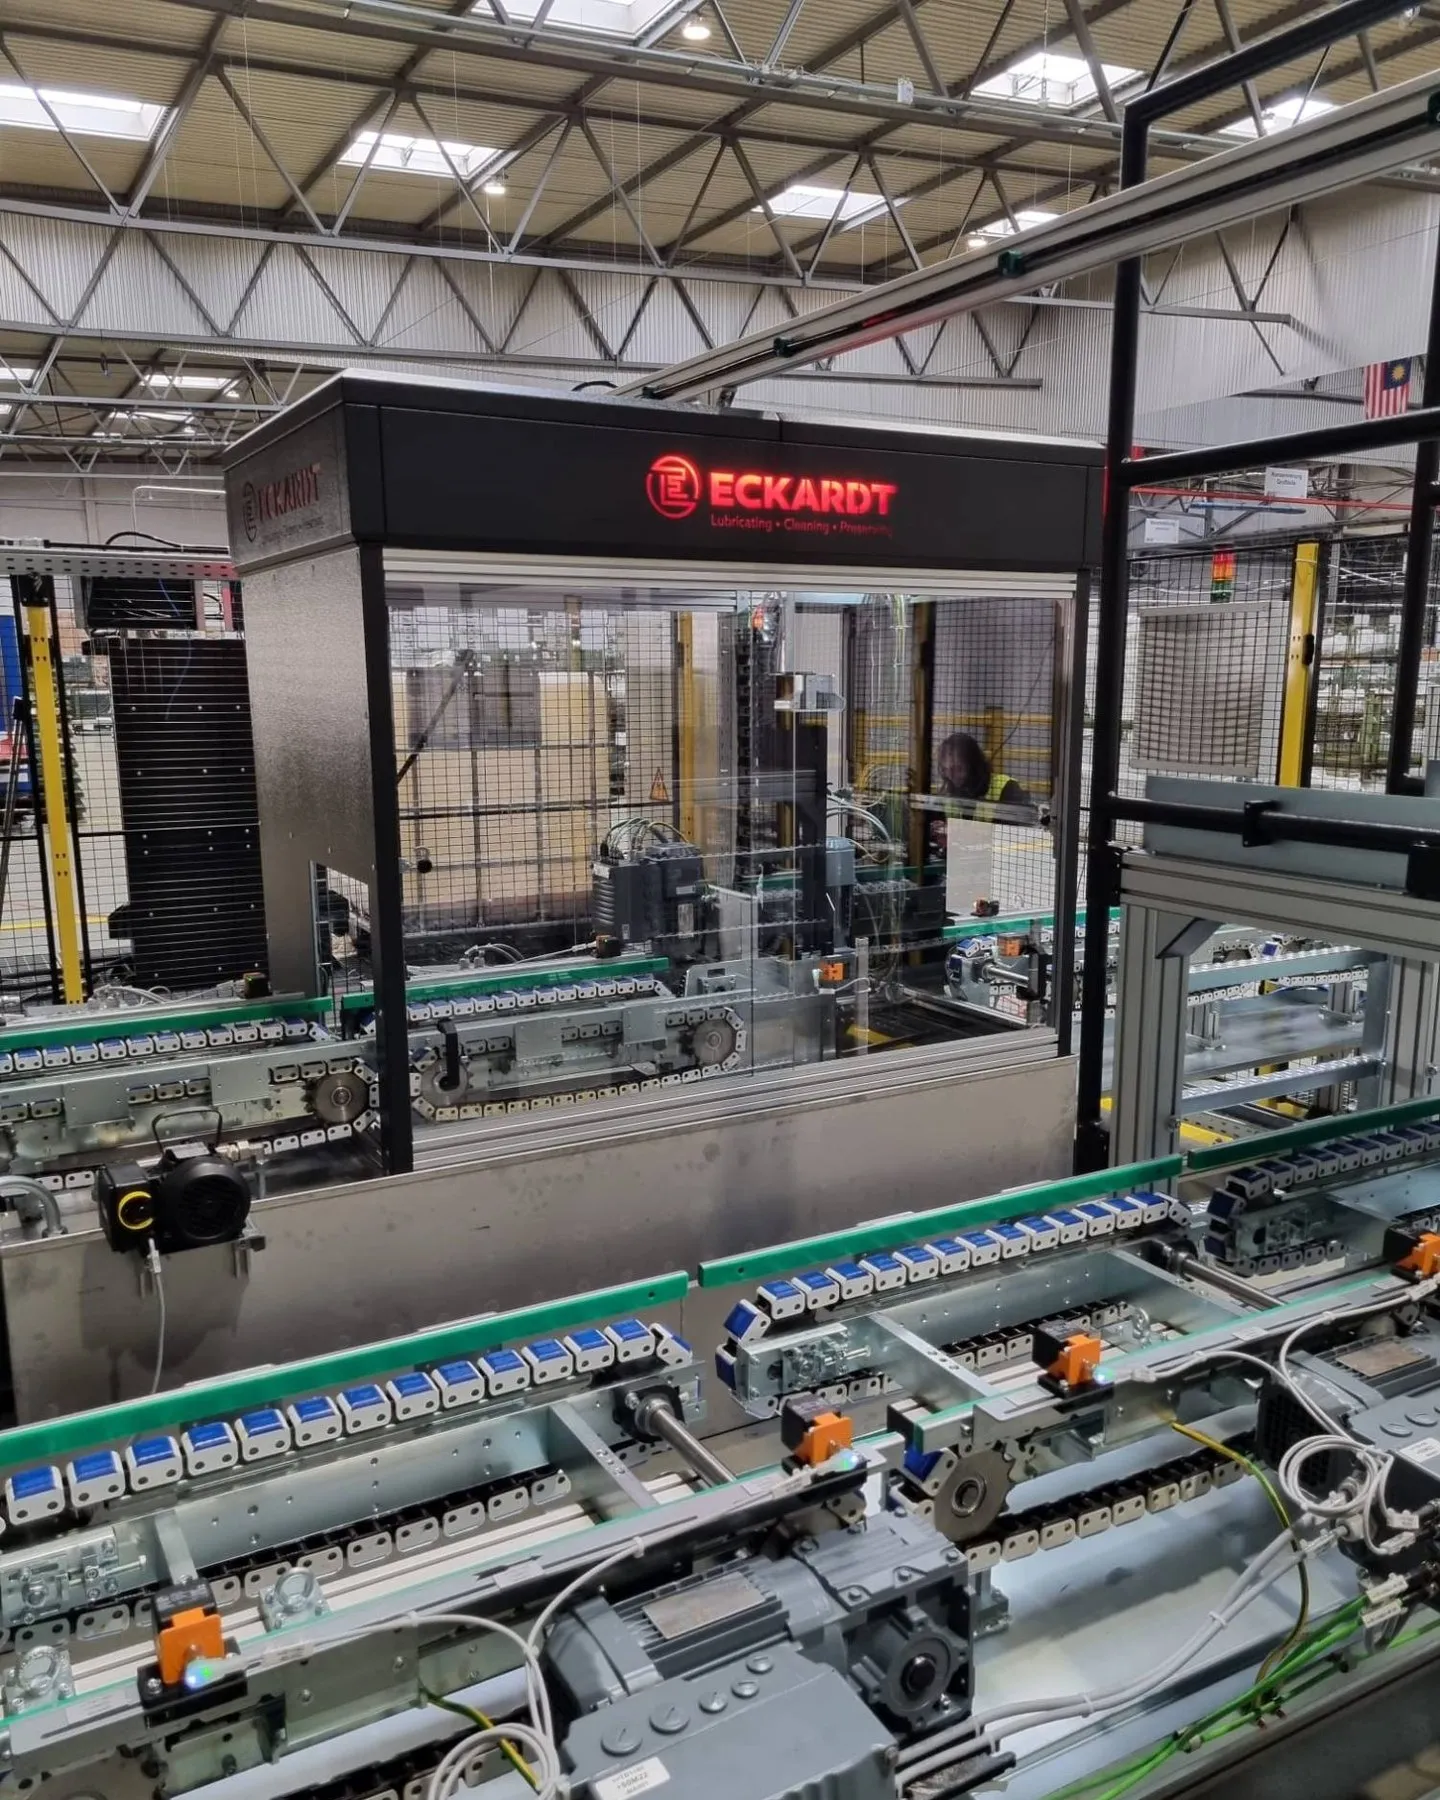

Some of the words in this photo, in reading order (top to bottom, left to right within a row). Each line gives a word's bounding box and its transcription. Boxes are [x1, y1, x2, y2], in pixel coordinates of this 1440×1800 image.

[709, 471, 899, 516] ECKARDT
[710, 514, 772, 533] Lubricating
[783, 518, 830, 535] Cleaning
